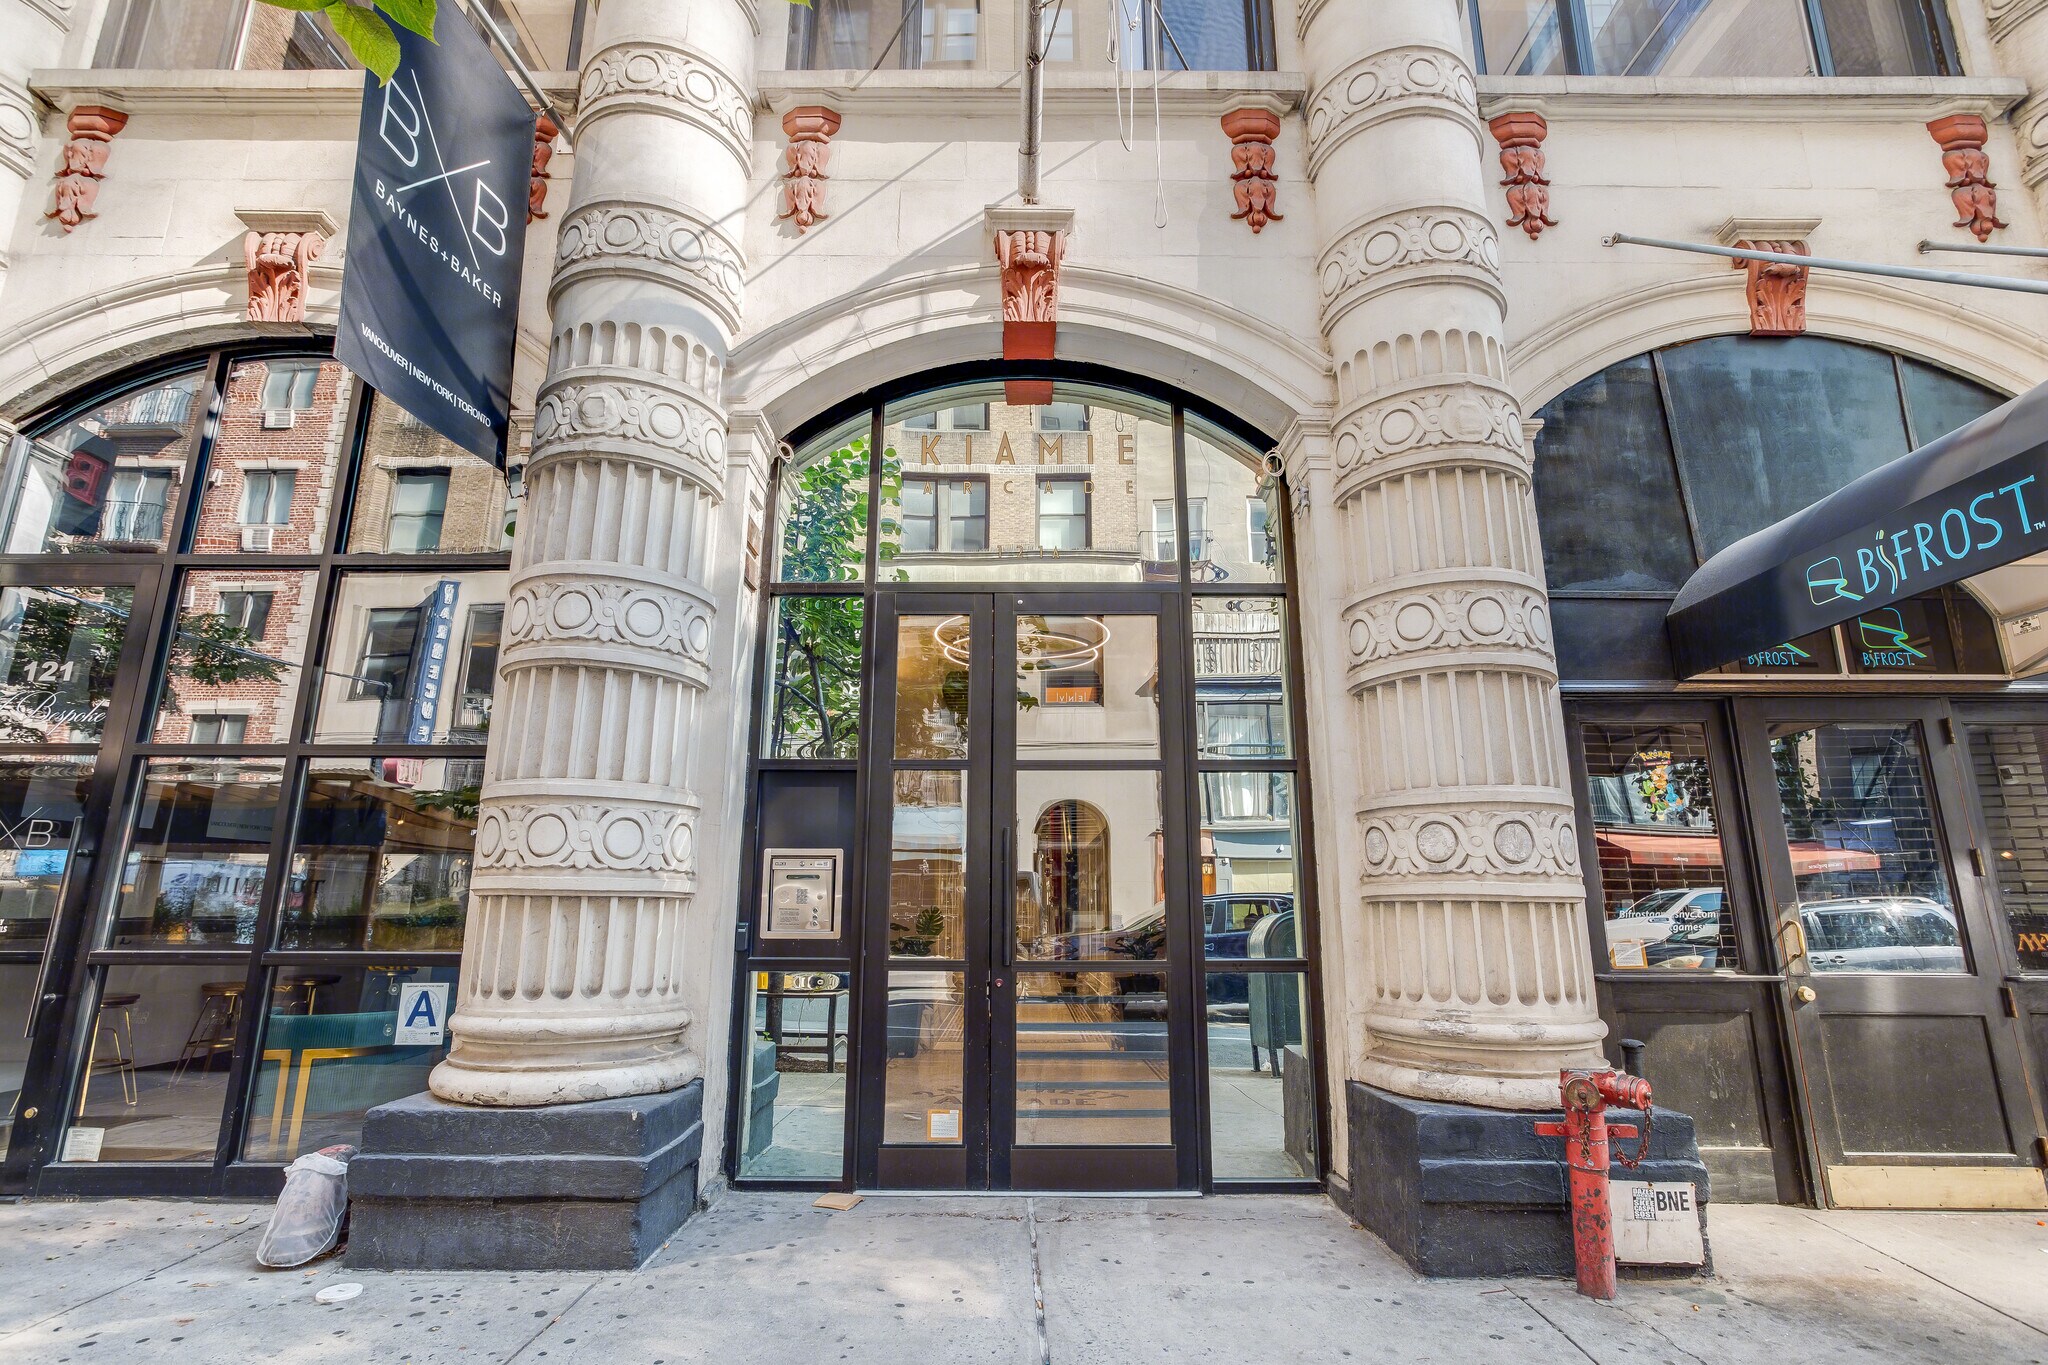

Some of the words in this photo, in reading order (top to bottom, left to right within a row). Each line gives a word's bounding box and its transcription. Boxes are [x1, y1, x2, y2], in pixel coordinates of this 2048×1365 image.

[361, 322, 408, 371] VANCOUVER
[413, 365, 432, 387] NEW
[432, 379, 453, 403] YORK
[456, 396, 492, 428] TORONTO
[921, 431, 1134, 466] KIAMIE
[922, 480, 1134, 495] ARCADE
[24, 661, 74, 681] 121
[17, 690, 107, 736] Bespoke
[404, 991, 437, 1027] A
[1656, 1191, 1689, 1211] BNE
